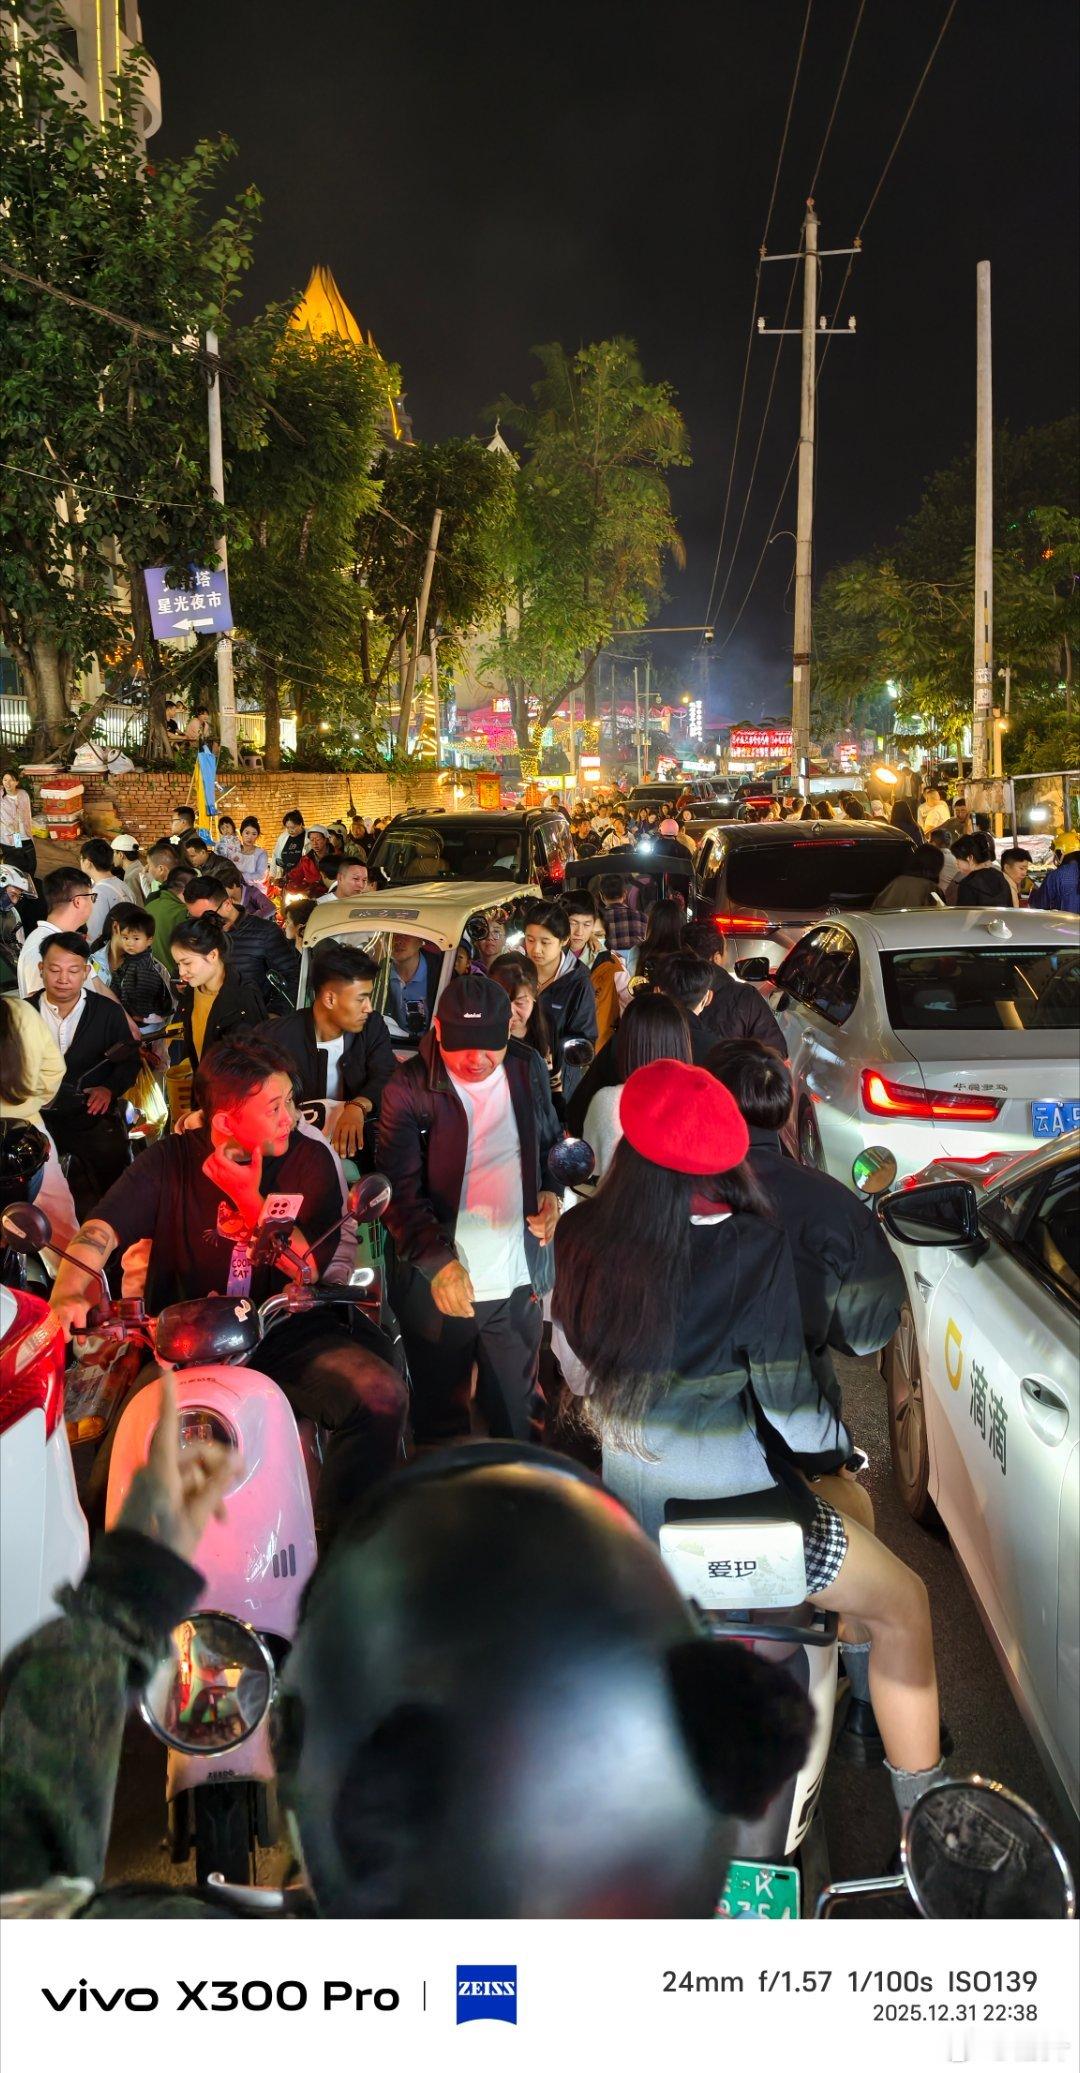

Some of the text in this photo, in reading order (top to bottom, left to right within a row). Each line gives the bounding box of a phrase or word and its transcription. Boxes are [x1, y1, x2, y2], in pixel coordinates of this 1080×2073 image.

[157, 591, 222, 615] 星光夜市
[232, 1269, 249, 1279] CAT
[969, 1358, 1008, 1476] 滴滴
